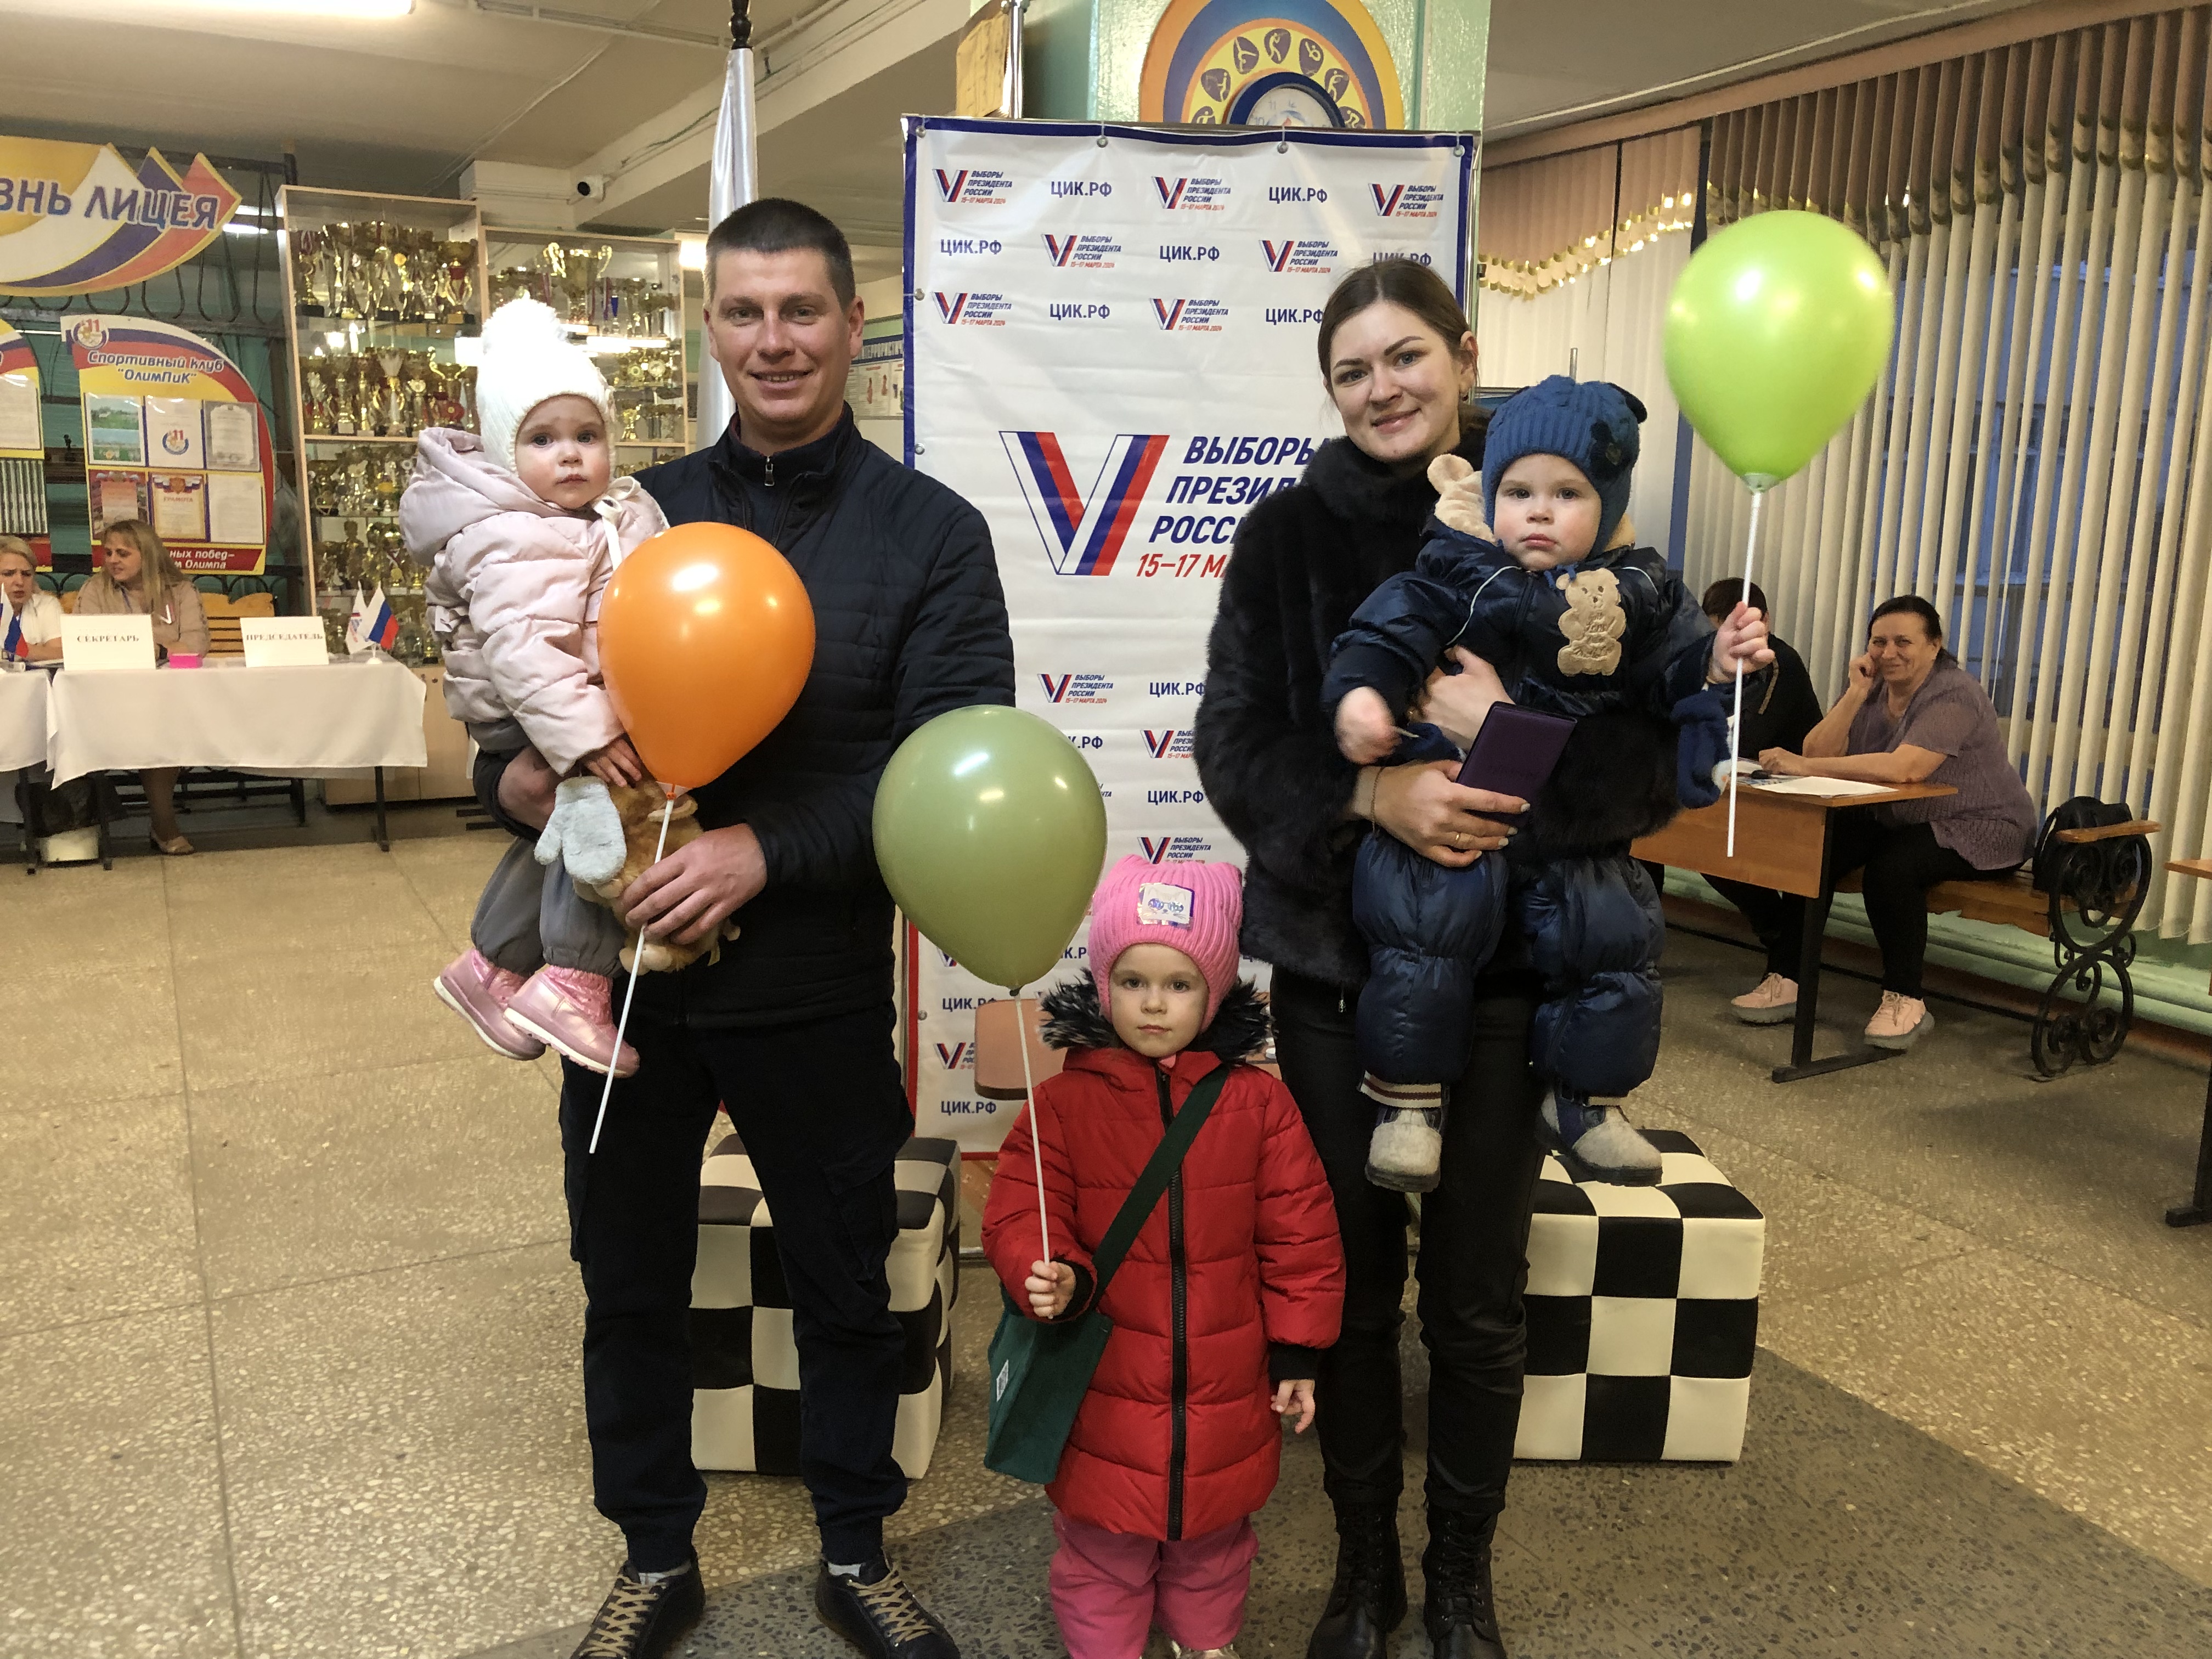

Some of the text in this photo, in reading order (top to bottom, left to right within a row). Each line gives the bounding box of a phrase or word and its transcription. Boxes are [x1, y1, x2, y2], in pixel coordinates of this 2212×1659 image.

[968, 179, 1012, 188] ПРЕЗИДЕНТА
[1051, 181, 1112, 197] ЦИК.РФ
[1269, 187, 1328, 203] ЦИК.РФ
[1403, 194, 1444, 202] ПРЕЗИДЕНТА
[84, 185, 218, 230] ЛИЦЕЯ
[941, 239, 1002, 256] ЦИК.РФ
[1077, 244, 1121, 252] ПРЕЗИДЕНТА
[1160, 246, 1220, 262] ЦИК.РФ
[1050, 304, 1110, 320] ЦИК.РФ
[88, 351, 185, 368] Спортивный
[170, 550, 192, 558] ных
[185, 560, 226, 569] Олимпа
[1200, 554, 1227, 578] М
[1149, 682, 1206, 696] ЦИК.РФ
[1148, 790, 1204, 805] ЦИК.РФ
[941, 1101, 997, 1114] ЦИК.РФ
